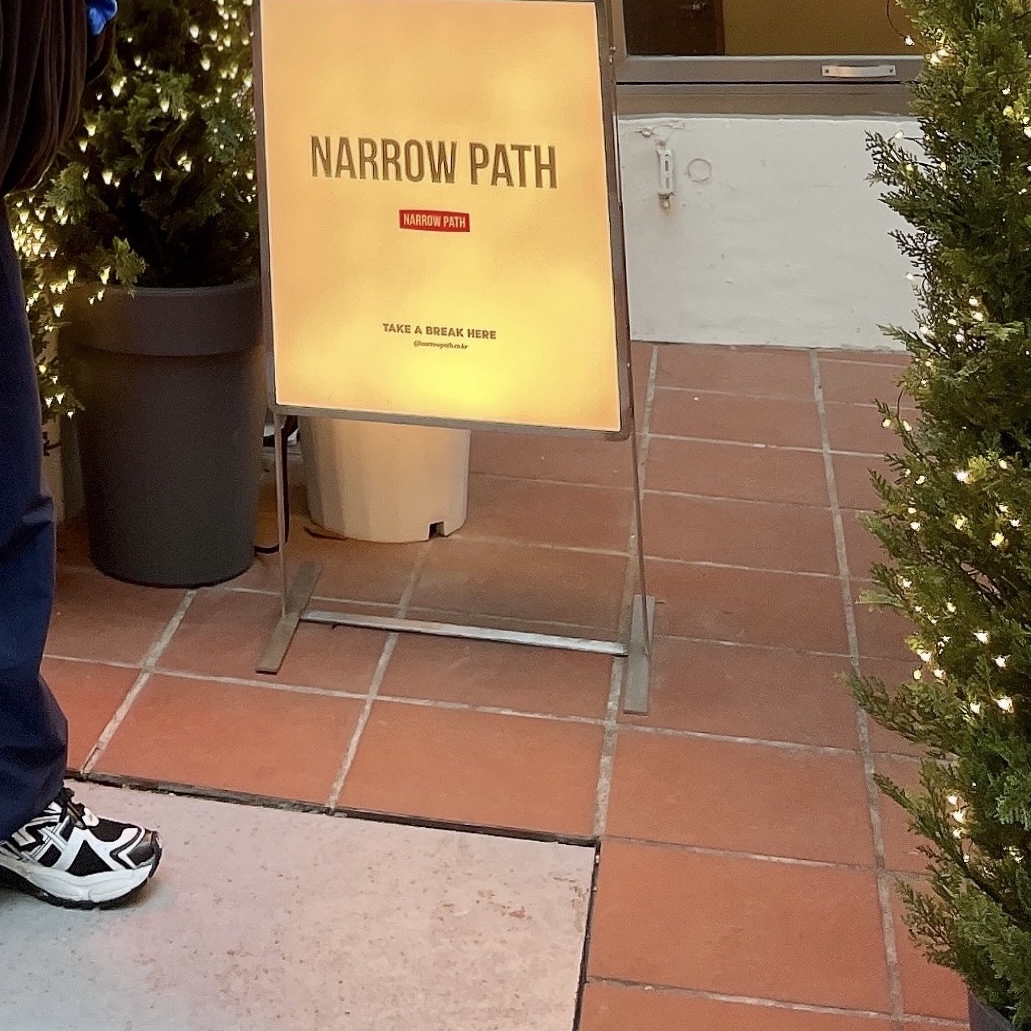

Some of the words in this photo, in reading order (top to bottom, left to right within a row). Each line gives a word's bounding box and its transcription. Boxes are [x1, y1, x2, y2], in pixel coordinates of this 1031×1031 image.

[310, 135, 457, 184] NARROW
[469, 142, 558, 189] PATH
[402, 213, 442, 228] NARROW
[443, 215, 467, 229] PATH
[383, 323, 411, 334] TAKE
[414, 325, 423, 335] A
[425, 326, 464, 337] BREAK
[467, 328, 497, 340] HERE
